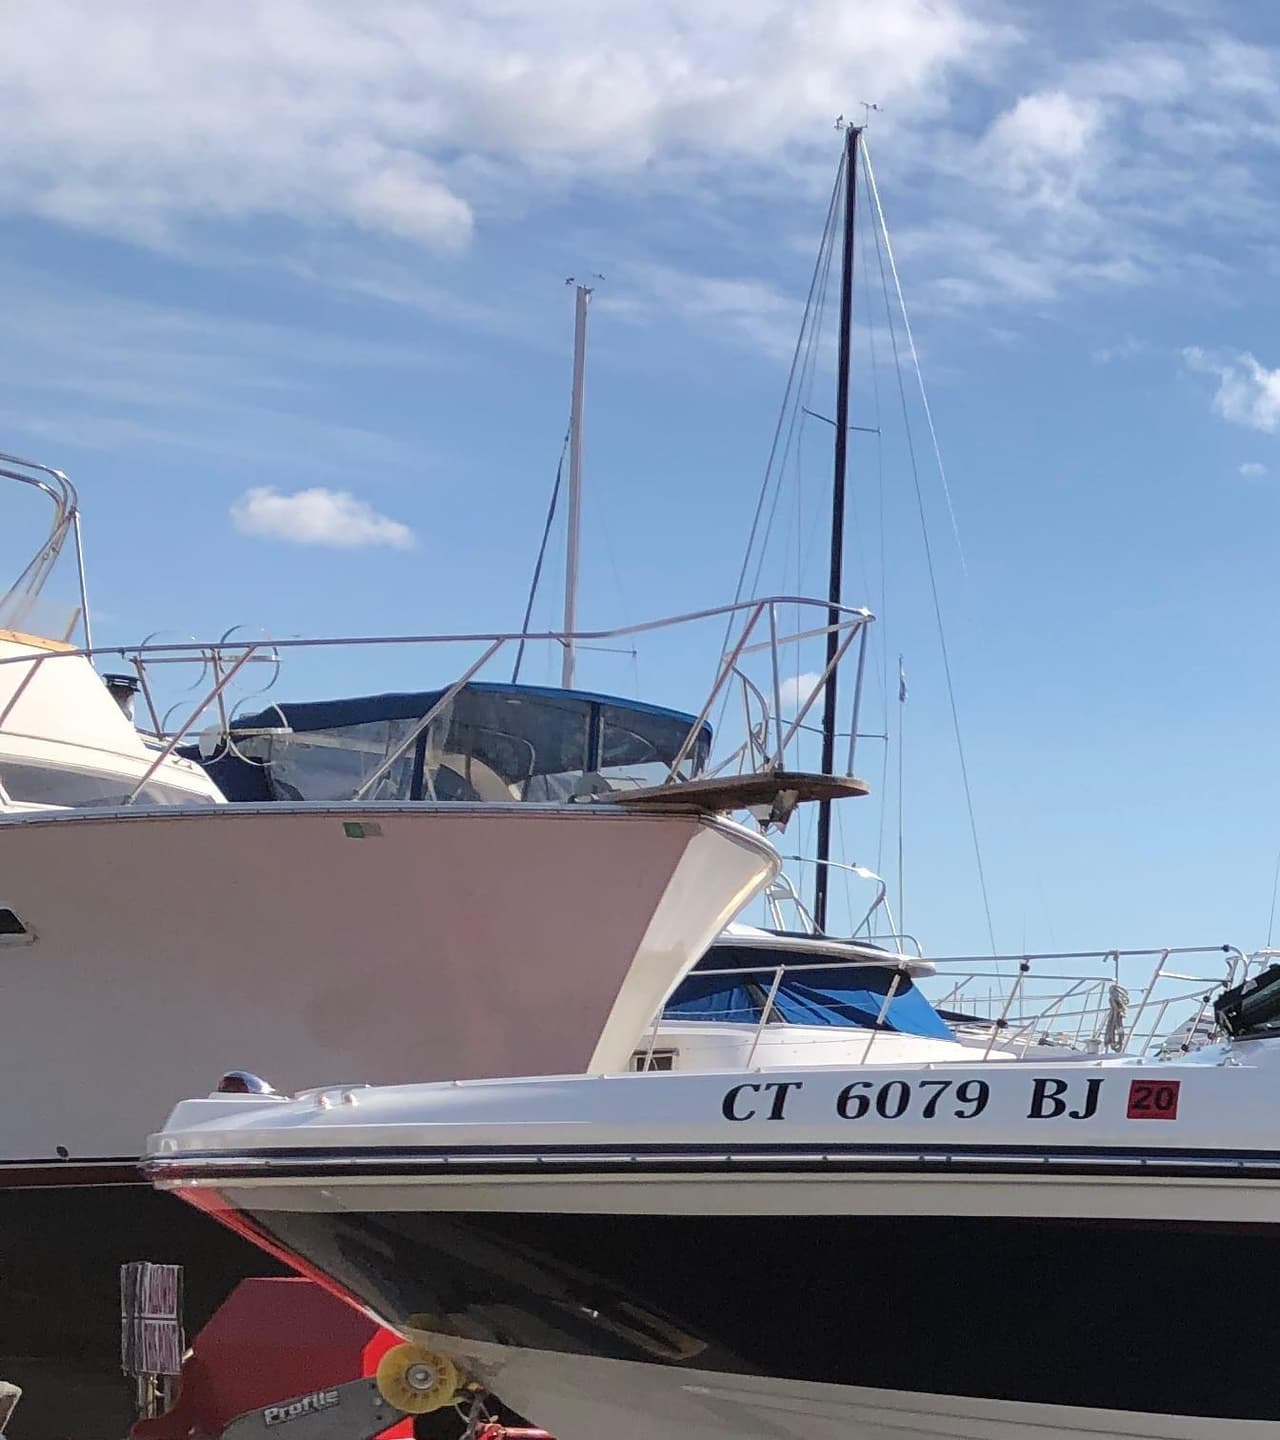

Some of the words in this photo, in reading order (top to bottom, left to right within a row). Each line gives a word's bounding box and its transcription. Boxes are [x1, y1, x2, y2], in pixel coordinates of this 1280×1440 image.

[722, 1081, 803, 1121] CT
[836, 1079, 991, 1120] 6079
[1026, 1078, 1105, 1121] BJ
[1132, 1085, 1177, 1112] 20
[264, 1391, 340, 1426] Profile
